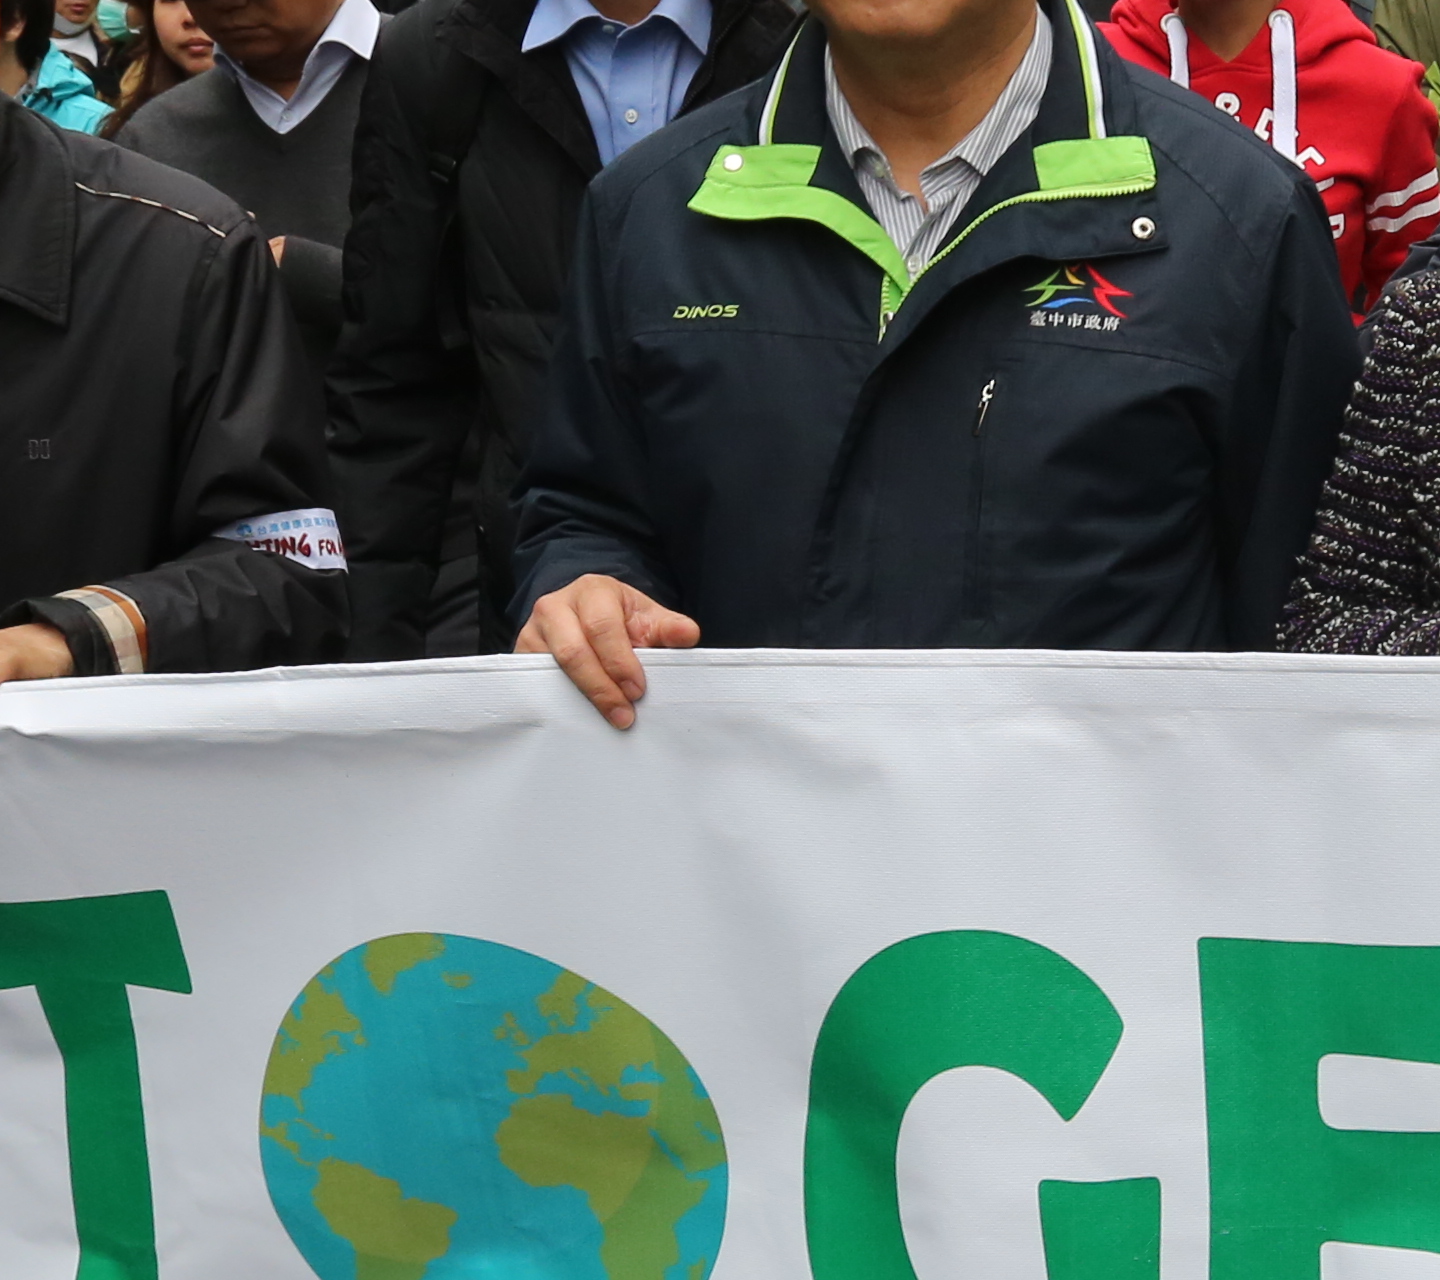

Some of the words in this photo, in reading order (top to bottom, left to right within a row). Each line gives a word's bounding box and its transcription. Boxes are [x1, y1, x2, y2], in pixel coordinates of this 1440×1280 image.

[673, 304, 739, 319] DINOS
[1030, 310, 1121, 332] 臺中市政府
